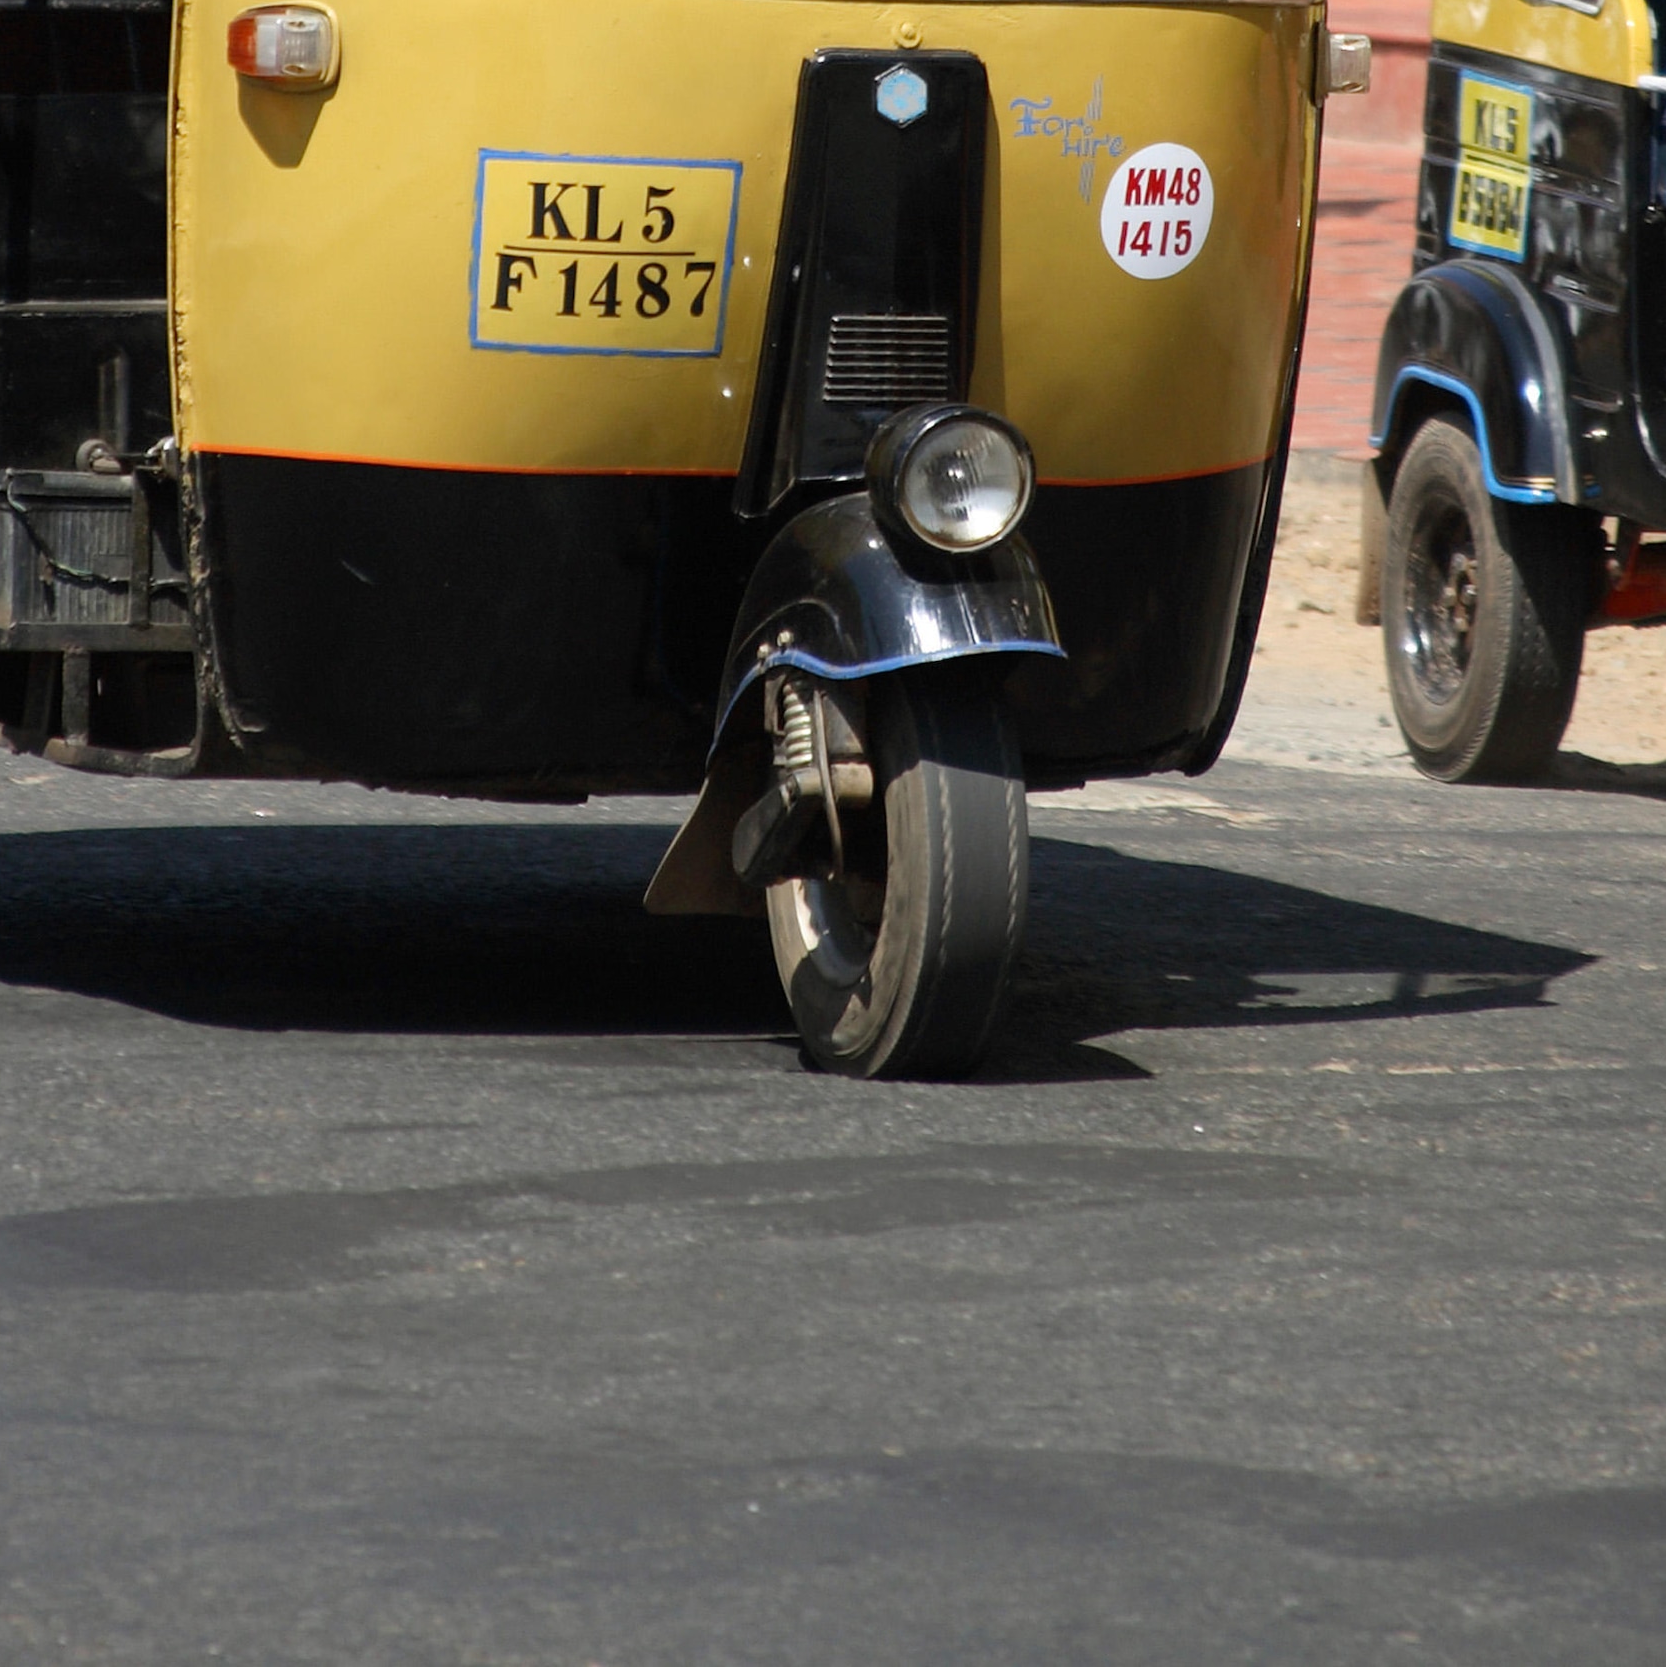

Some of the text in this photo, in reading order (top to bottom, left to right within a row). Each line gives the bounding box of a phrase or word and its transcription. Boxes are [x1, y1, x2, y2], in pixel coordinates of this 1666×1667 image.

[1061, 134, 1127, 158] Hire
[526, 181, 677, 244] KL 5
[1117, 219, 1194, 258] 1415
[555, 258, 718, 319] 1487
